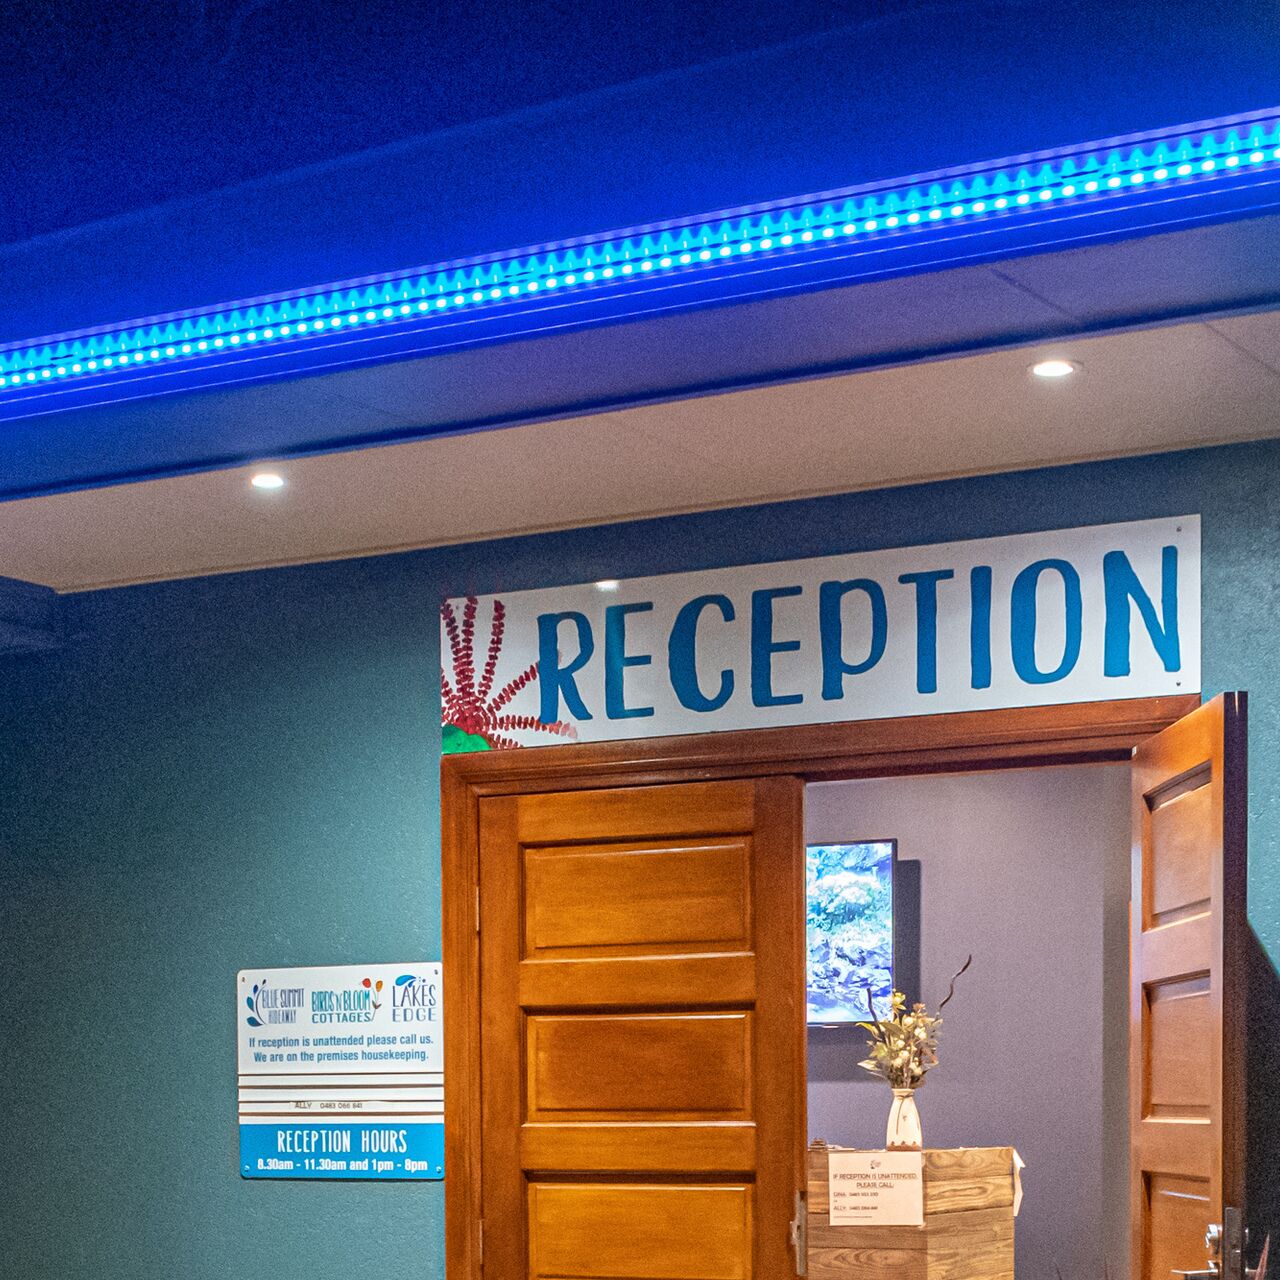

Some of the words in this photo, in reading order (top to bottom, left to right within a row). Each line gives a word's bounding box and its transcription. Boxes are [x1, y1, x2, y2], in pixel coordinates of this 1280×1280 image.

[537, 545, 1179, 724] RECEPTION
[280, 987, 304, 1008] SUMMIT
[312, 991, 334, 1012] BIRDS
[343, 990, 370, 1011] BLOOM
[392, 984, 436, 1007] LAKES
[312, 1012, 371, 1024] COTTAGES
[392, 1007, 437, 1023] EDGE
[249, 1038, 255, 1047] If
[258, 1037, 300, 1049] reception
[302, 1037, 310, 1046] is
[313, 1035, 364, 1046] unattended
[367, 1035, 397, 1047] please
[400, 1034, 417, 1044] call
[420, 1035, 434, 1044] us.
[254, 1052, 267, 1062] We
[270, 1054, 284, 1062] are
[286, 1054, 297, 1062] on
[300, 1051, 314, 1061] the
[317, 1051, 359, 1064] premises
[361, 1050, 429, 1063] housekeeping.
[277, 1130, 351, 1153] RECEPTION
[361, 1129, 407, 1153] HOURS
[257, 1158, 294, 1171] 8.30am
[304, 1158, 347, 1171] 11.30am
[349, 1158, 368, 1171] and
[371, 1158, 394, 1174] 1pm
[404, 1158, 428, 1174] 8pm
